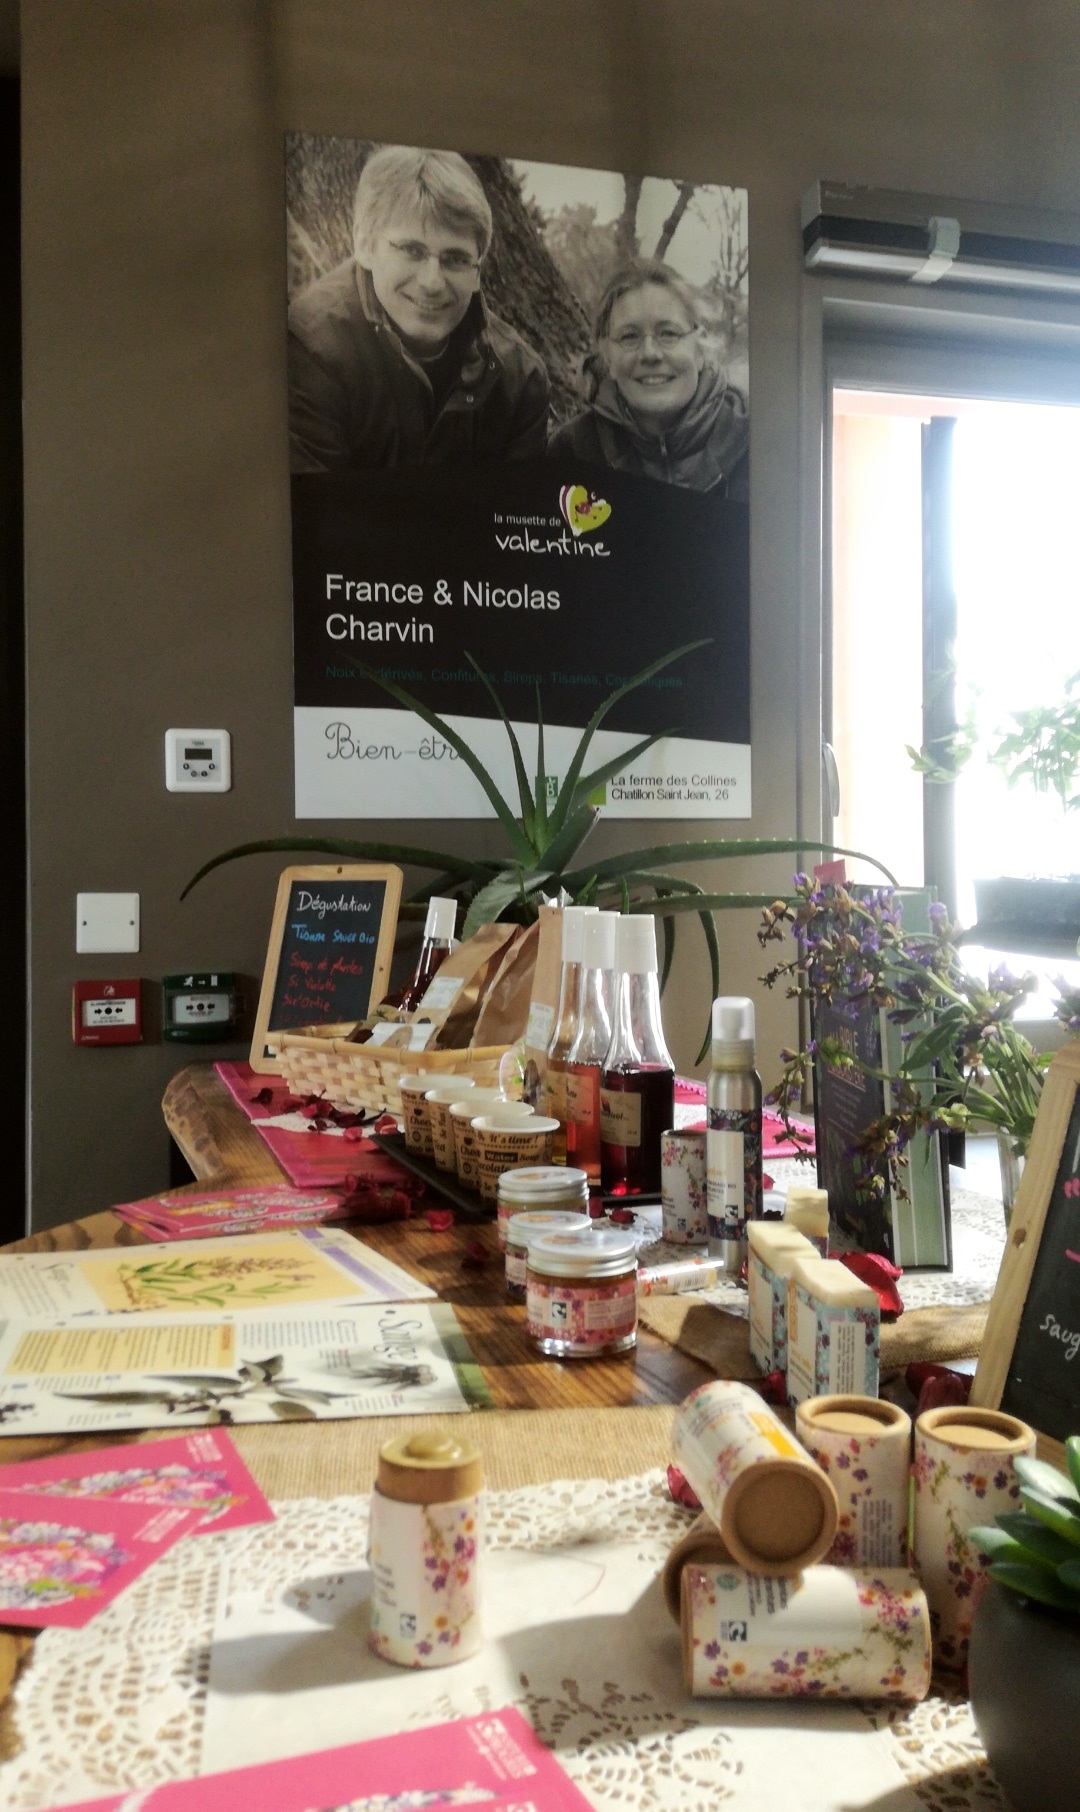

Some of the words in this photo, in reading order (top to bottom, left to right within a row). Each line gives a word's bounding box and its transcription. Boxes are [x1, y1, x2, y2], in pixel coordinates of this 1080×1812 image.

[494, 513, 503, 524] la
[506, 514, 546, 526] musette
[549, 515, 561, 527] de
[495, 527, 611, 557] valentine
[326, 573, 424, 604] France
[433, 579, 453, 606] &
[463, 580, 561, 610] Nicolas
[326, 613, 434, 643] Charvin
[611, 776, 626, 786] La
[630, 775, 663, 786] ferme
[667, 775, 688, 786] des
[691, 775, 736, 787] Collines
[656, 789, 682, 800] Saint
[684, 789, 711, 802] Jean,
[715, 789, 729, 800] 26
[296, 891, 371, 920] Dégustation
